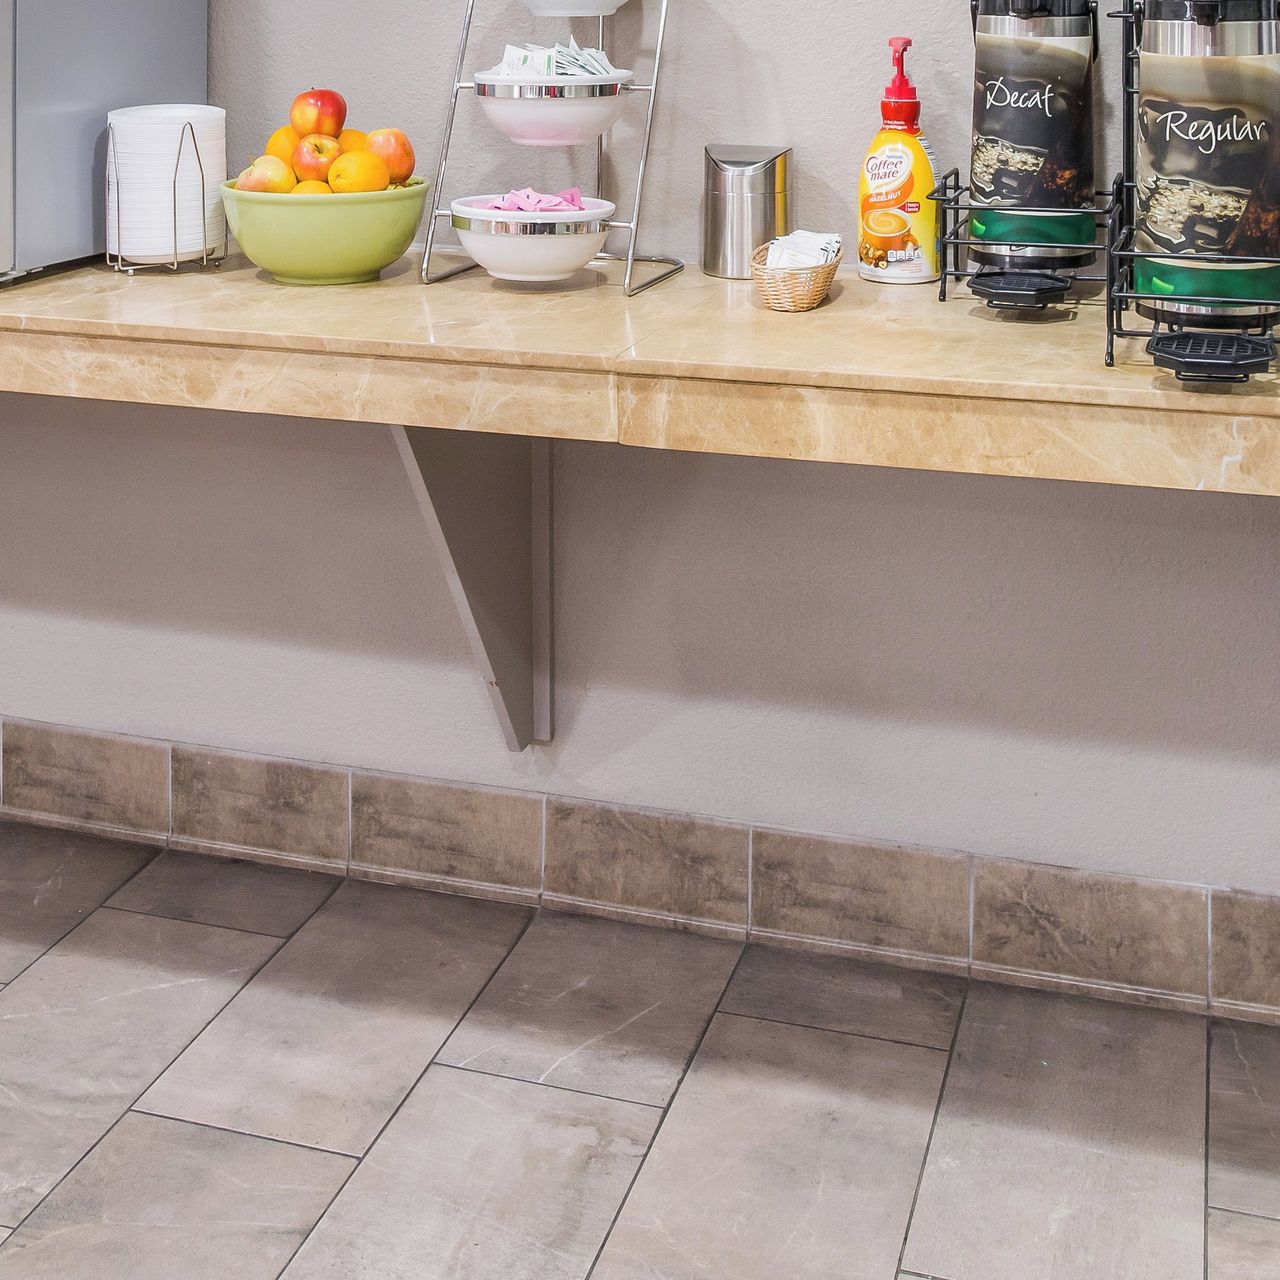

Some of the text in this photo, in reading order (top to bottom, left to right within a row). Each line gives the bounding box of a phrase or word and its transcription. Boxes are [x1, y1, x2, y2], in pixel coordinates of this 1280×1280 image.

[985, 76, 1055, 118] Decaf
[1155, 110, 1266, 155] Regular
[866, 156, 903, 173] Coffee
[870, 170, 899, 181] mate
